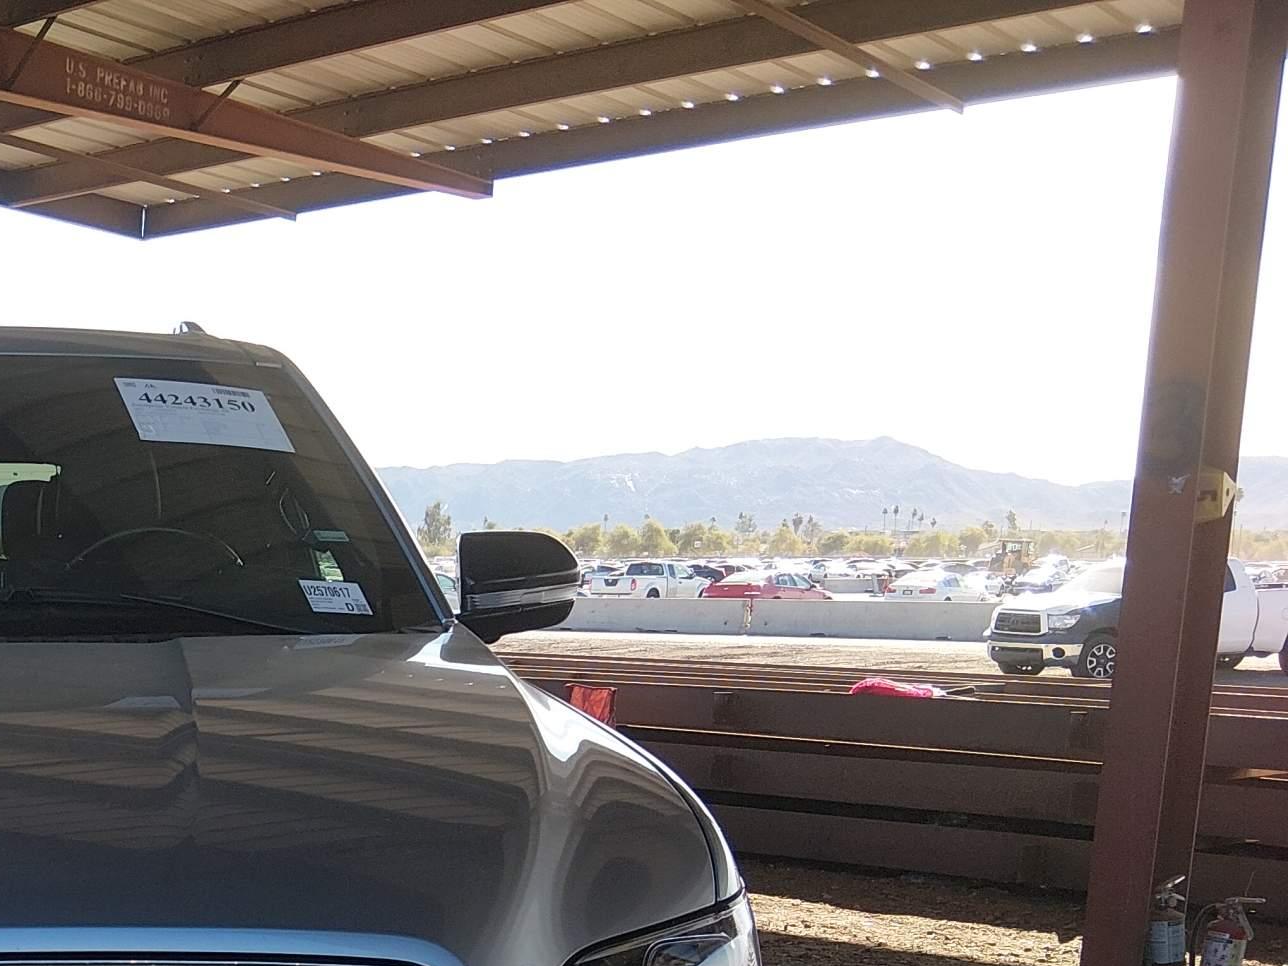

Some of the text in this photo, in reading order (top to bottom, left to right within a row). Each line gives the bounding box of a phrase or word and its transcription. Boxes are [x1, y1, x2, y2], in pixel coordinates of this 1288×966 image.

[96, 66, 144, 97] PREFAB
[138, 392, 256, 413] 44243150
[303, 585, 351, 598] U2570617
[345, 602, 355, 611] D
